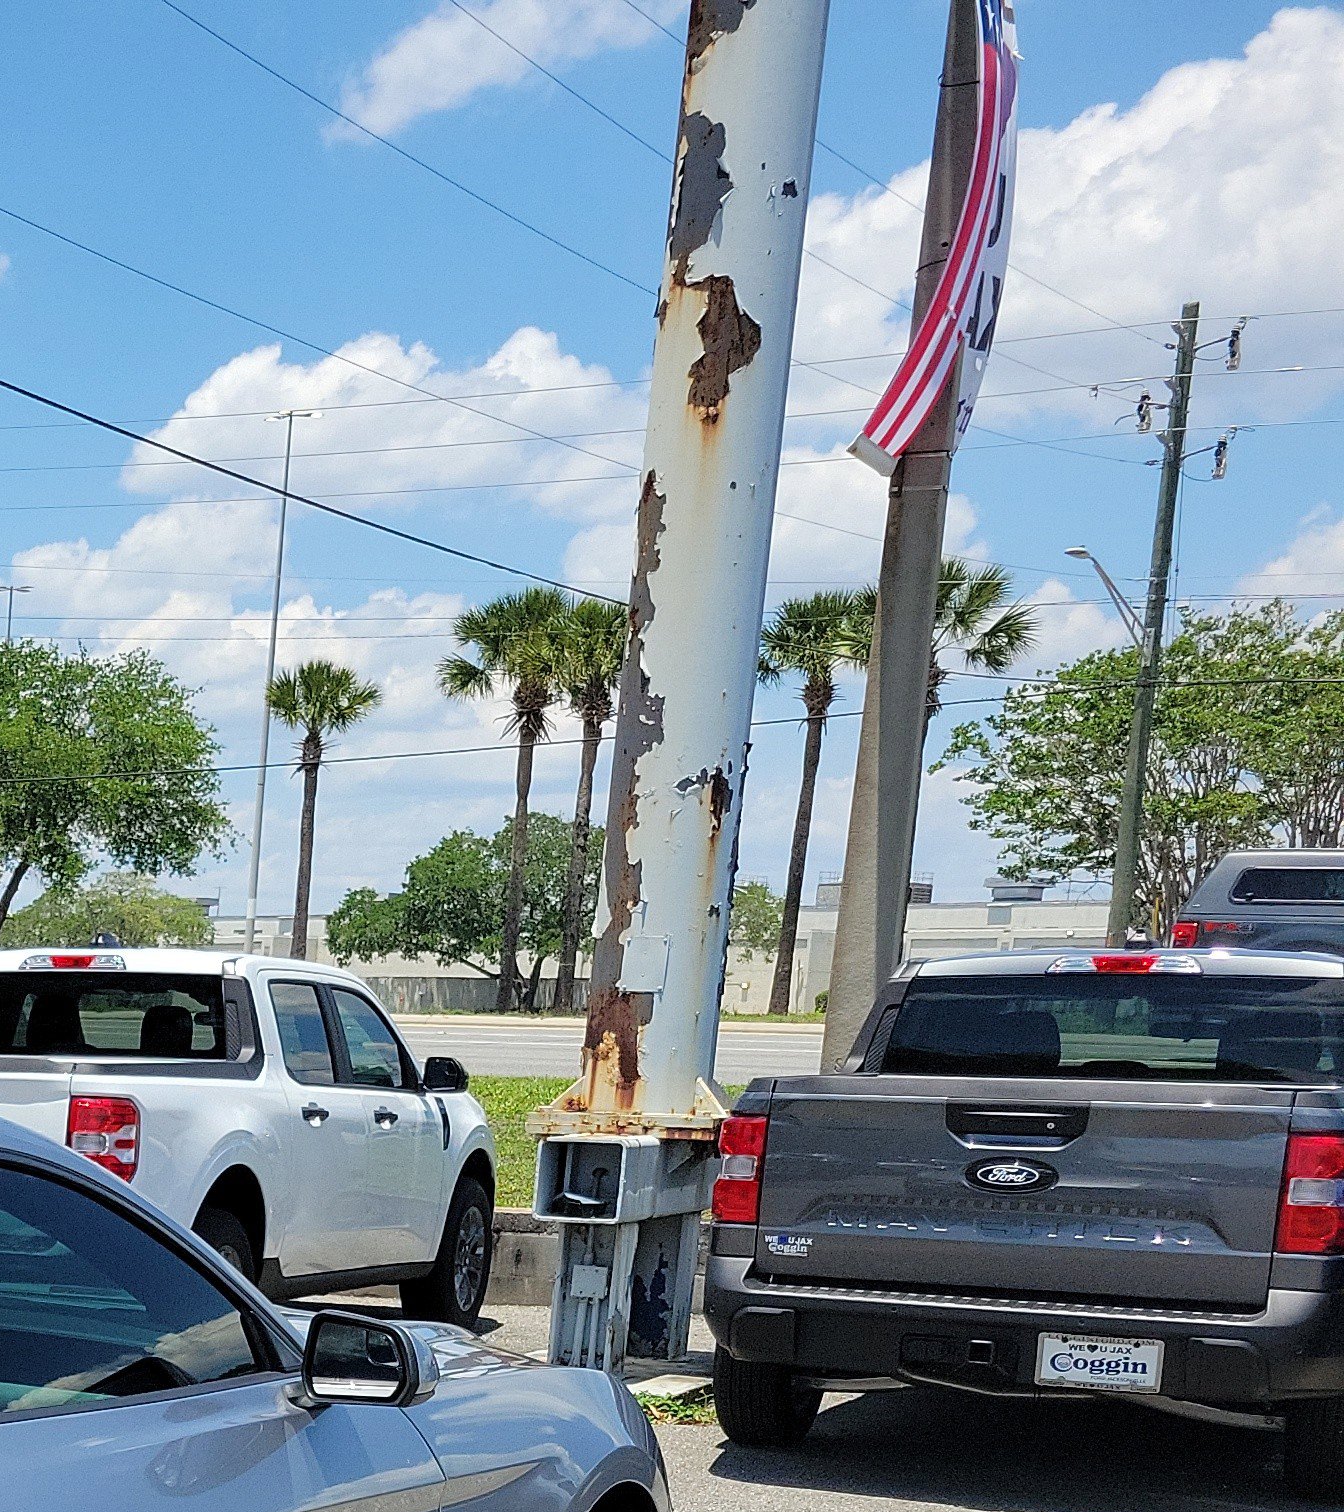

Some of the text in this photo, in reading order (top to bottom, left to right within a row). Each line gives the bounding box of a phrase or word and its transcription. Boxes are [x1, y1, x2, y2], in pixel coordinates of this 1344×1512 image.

[987, 1167, 1028, 1182] Ford
[764, 1234, 814, 1245] WE U JAX
[768, 1242, 808, 1253] Coggin
[1068, 1343, 1133, 1355] WE U JAX
[1049, 1352, 1148, 1376] Coggin
